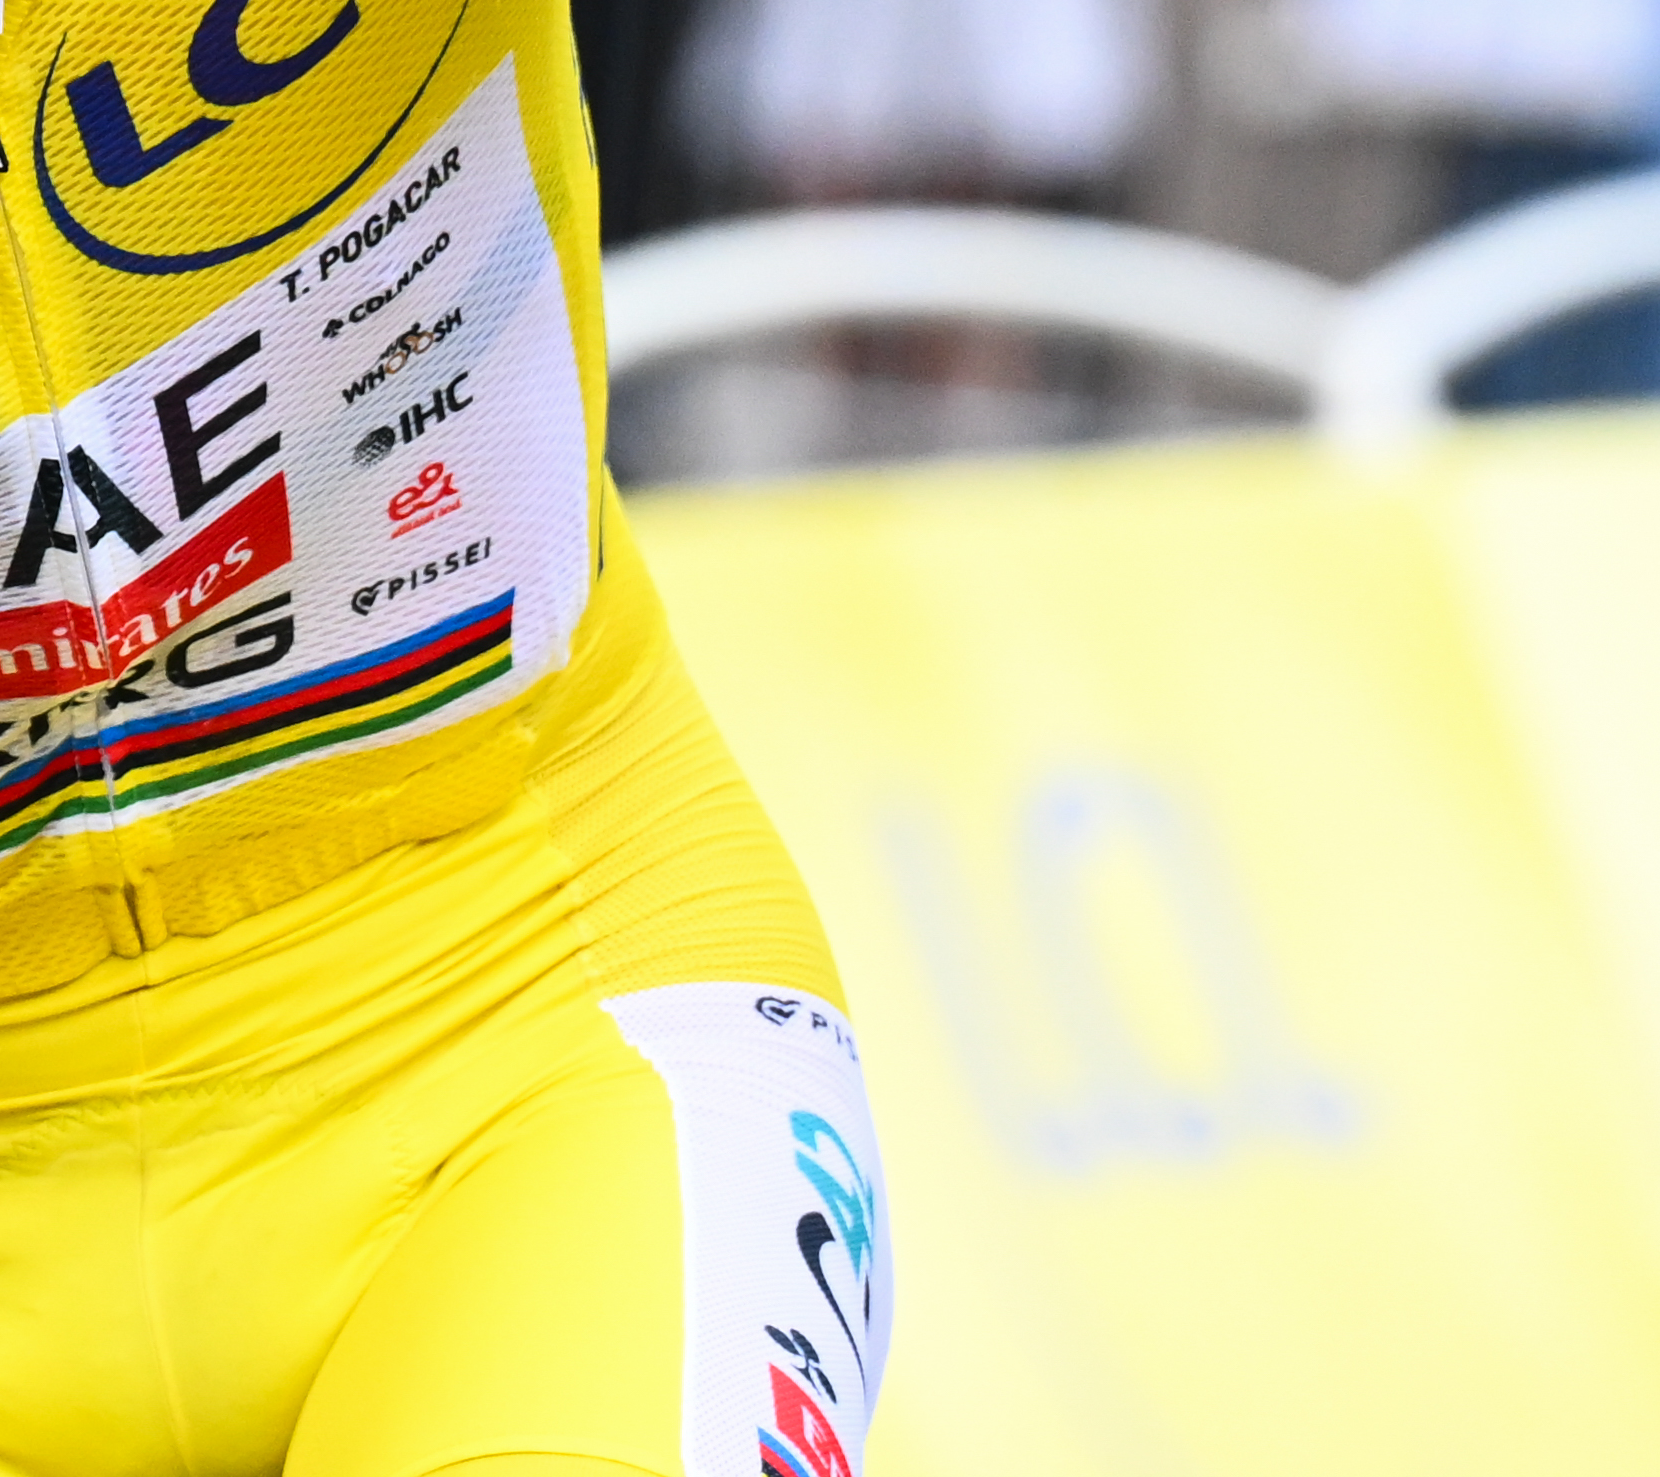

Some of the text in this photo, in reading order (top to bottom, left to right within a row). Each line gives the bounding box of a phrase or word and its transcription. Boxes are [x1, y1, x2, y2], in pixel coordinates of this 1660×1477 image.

[281, 272, 311, 303] T.
[348, 231, 451, 325] COLNAGO
[399, 371, 474, 446] IHC
[387, 536, 491, 601] PISSEI
